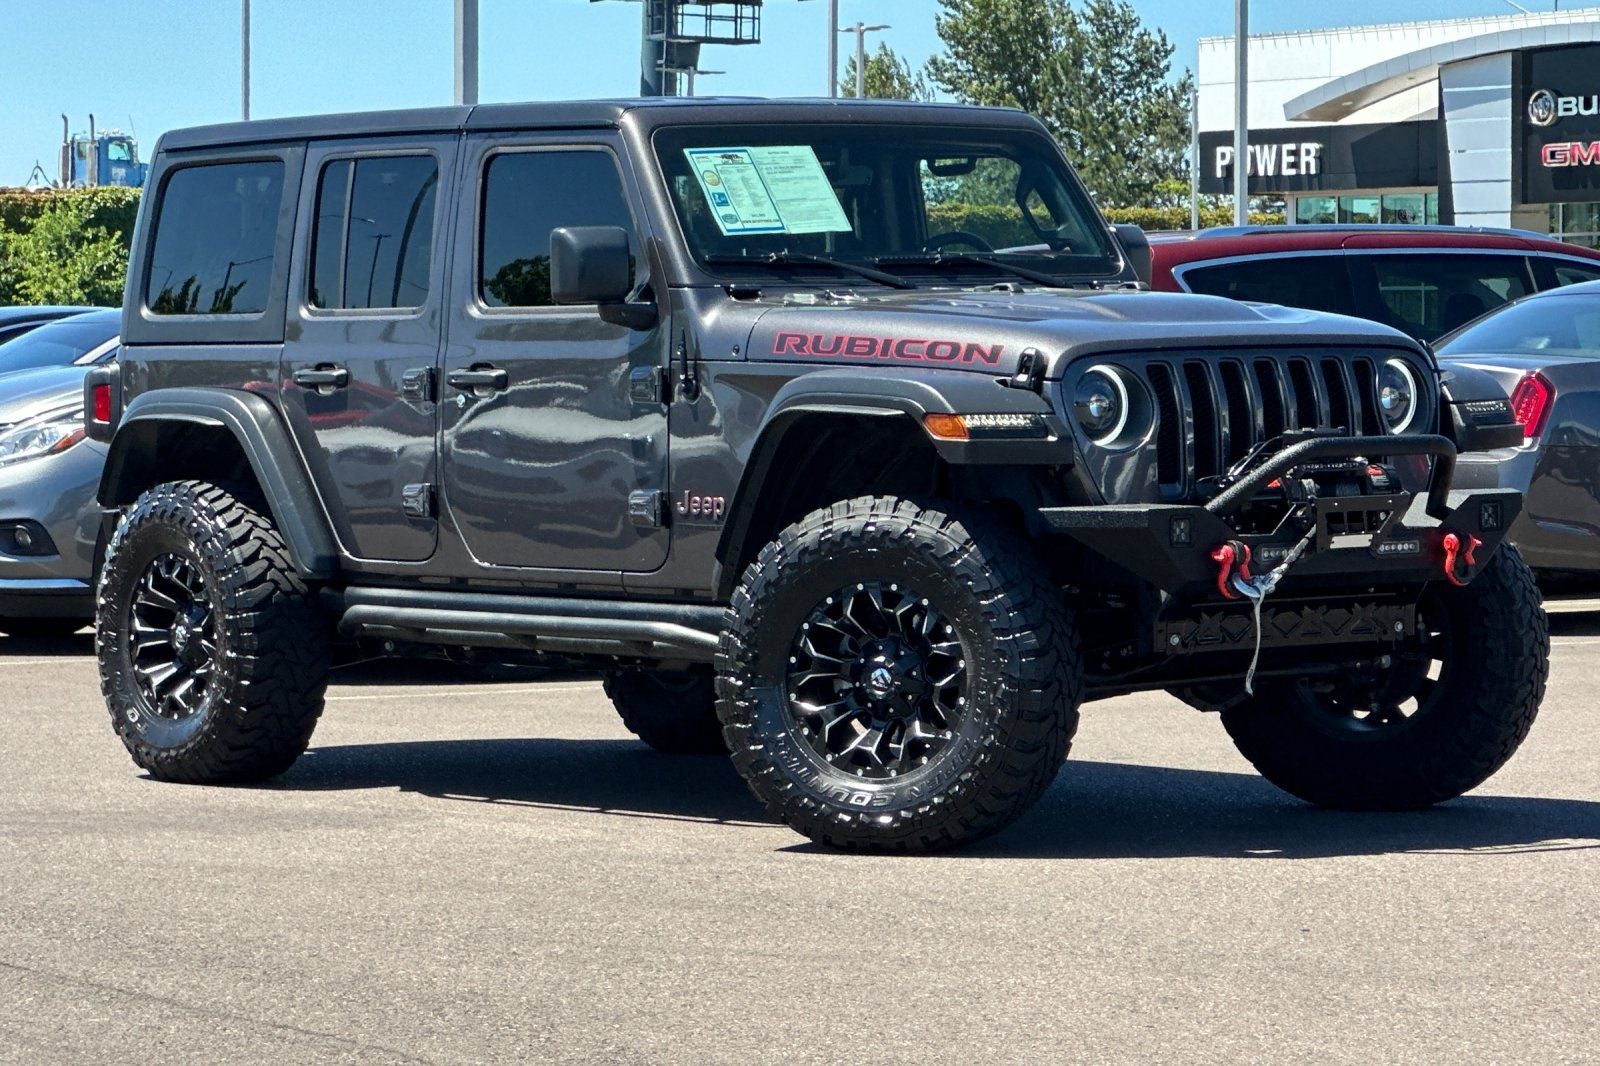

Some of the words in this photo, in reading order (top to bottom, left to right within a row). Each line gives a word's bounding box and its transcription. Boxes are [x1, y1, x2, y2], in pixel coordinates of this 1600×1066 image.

[1557, 95, 1600, 117] BU
[772, 331, 1005, 366] RUBICON
[676, 489, 726, 521] Jeep
